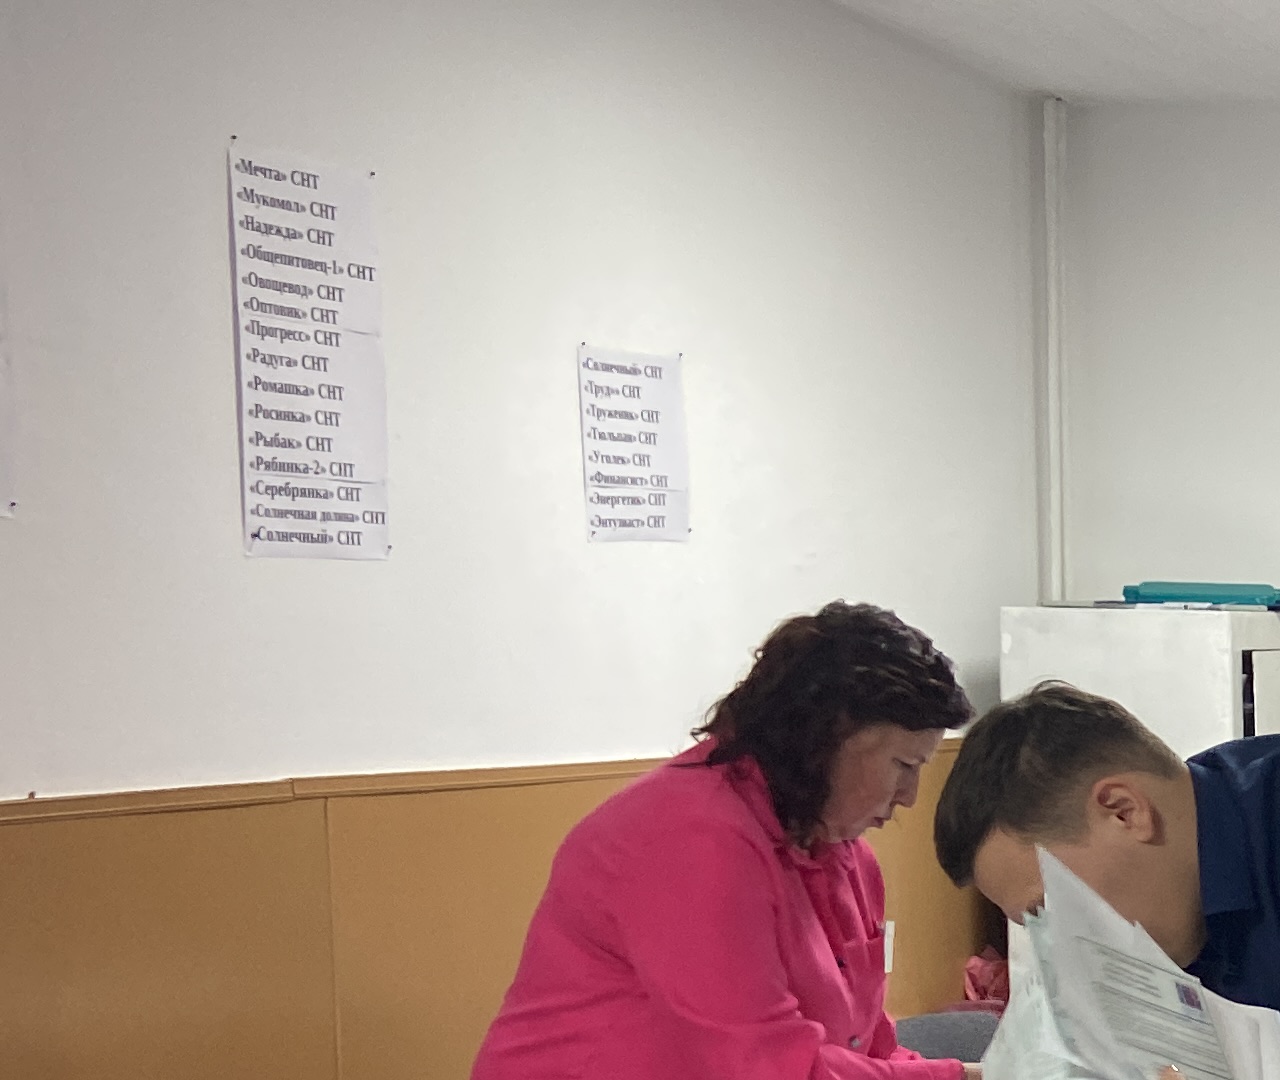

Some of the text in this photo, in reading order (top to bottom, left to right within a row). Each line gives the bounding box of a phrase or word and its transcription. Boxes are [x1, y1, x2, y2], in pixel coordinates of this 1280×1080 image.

[235, 158, 319, 189] «Мечта» СНТ
[310, 201, 337, 220] СНТ
[239, 215, 334, 247] «Надежда» СНТ
[347, 263, 375, 281] СНТ
[317, 284, 344, 302] СНТ
[311, 307, 338, 325] СНТ
[245, 320, 341, 347] «Прогресс» СНТ
[246, 348, 329, 372] «Радуга» СНТ
[247, 375, 344, 401] «Ромашка» СНТ
[315, 410, 340, 427] СНТ
[249, 431, 333, 452] «Рыбак» СНТ
[330, 462, 355, 477] СНТ
[337, 487, 362, 502] СНТ
